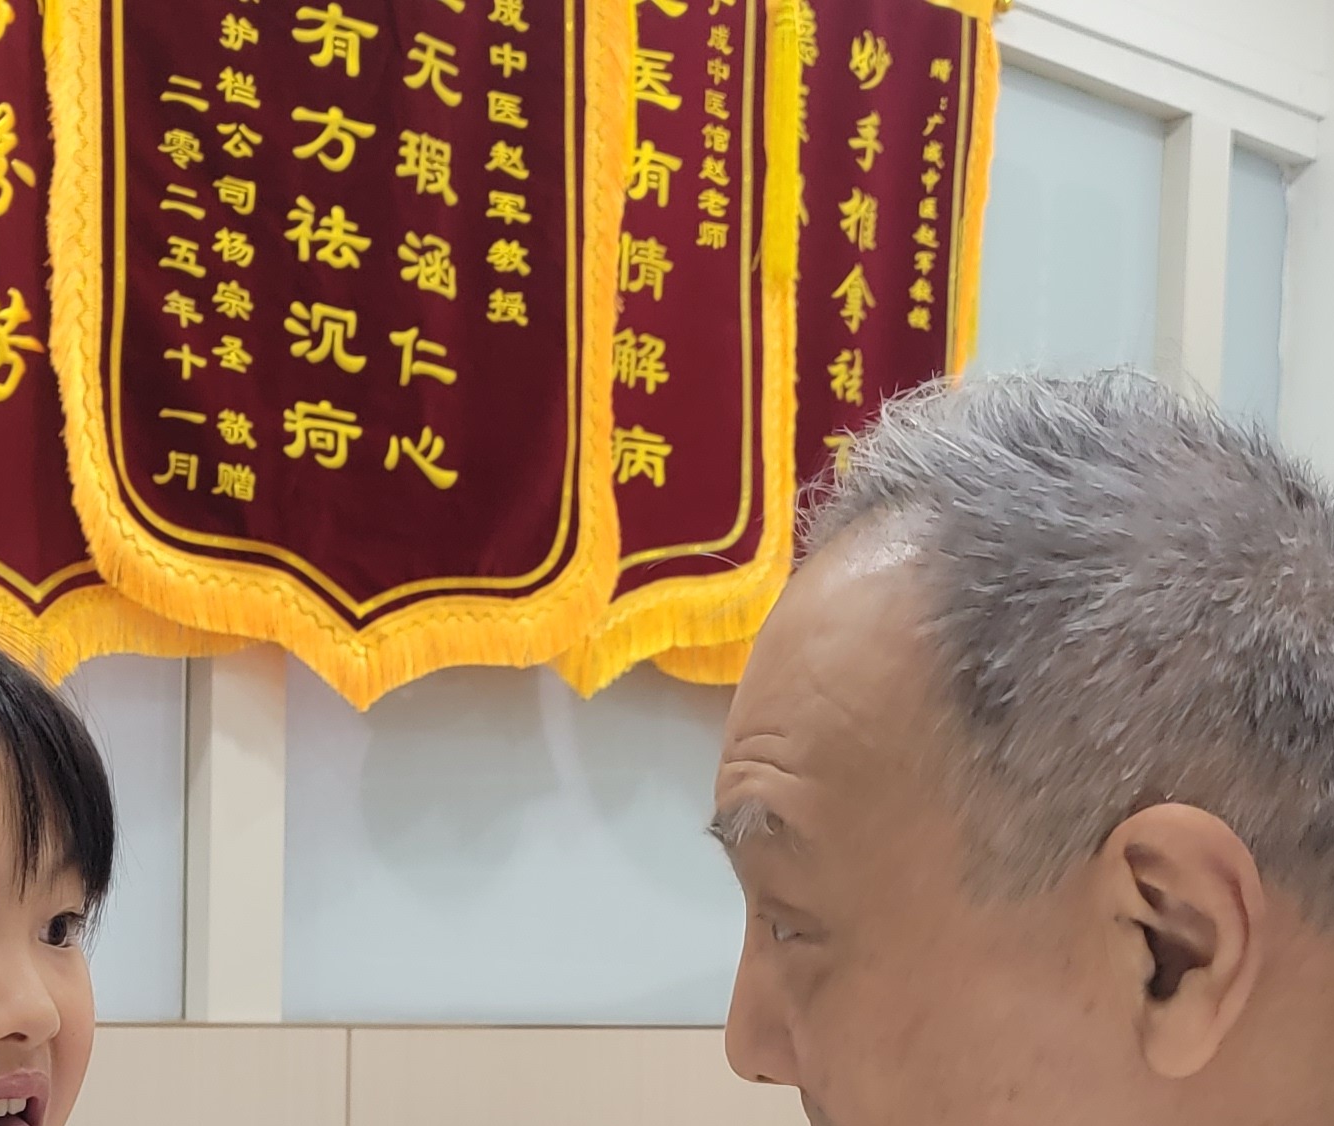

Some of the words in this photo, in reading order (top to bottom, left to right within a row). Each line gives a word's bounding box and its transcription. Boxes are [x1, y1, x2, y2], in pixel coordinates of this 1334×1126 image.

[153, 74, 210, 491] 二零二五年十一月
[212, 0, 263, 373] 护栏公司杨宗圣
[282, 2, 379, 469] 有方祛沉疴
[383, 0, 466, 490] 无瑕涵仁心
[612, 0, 688, 488] 医有情解病
